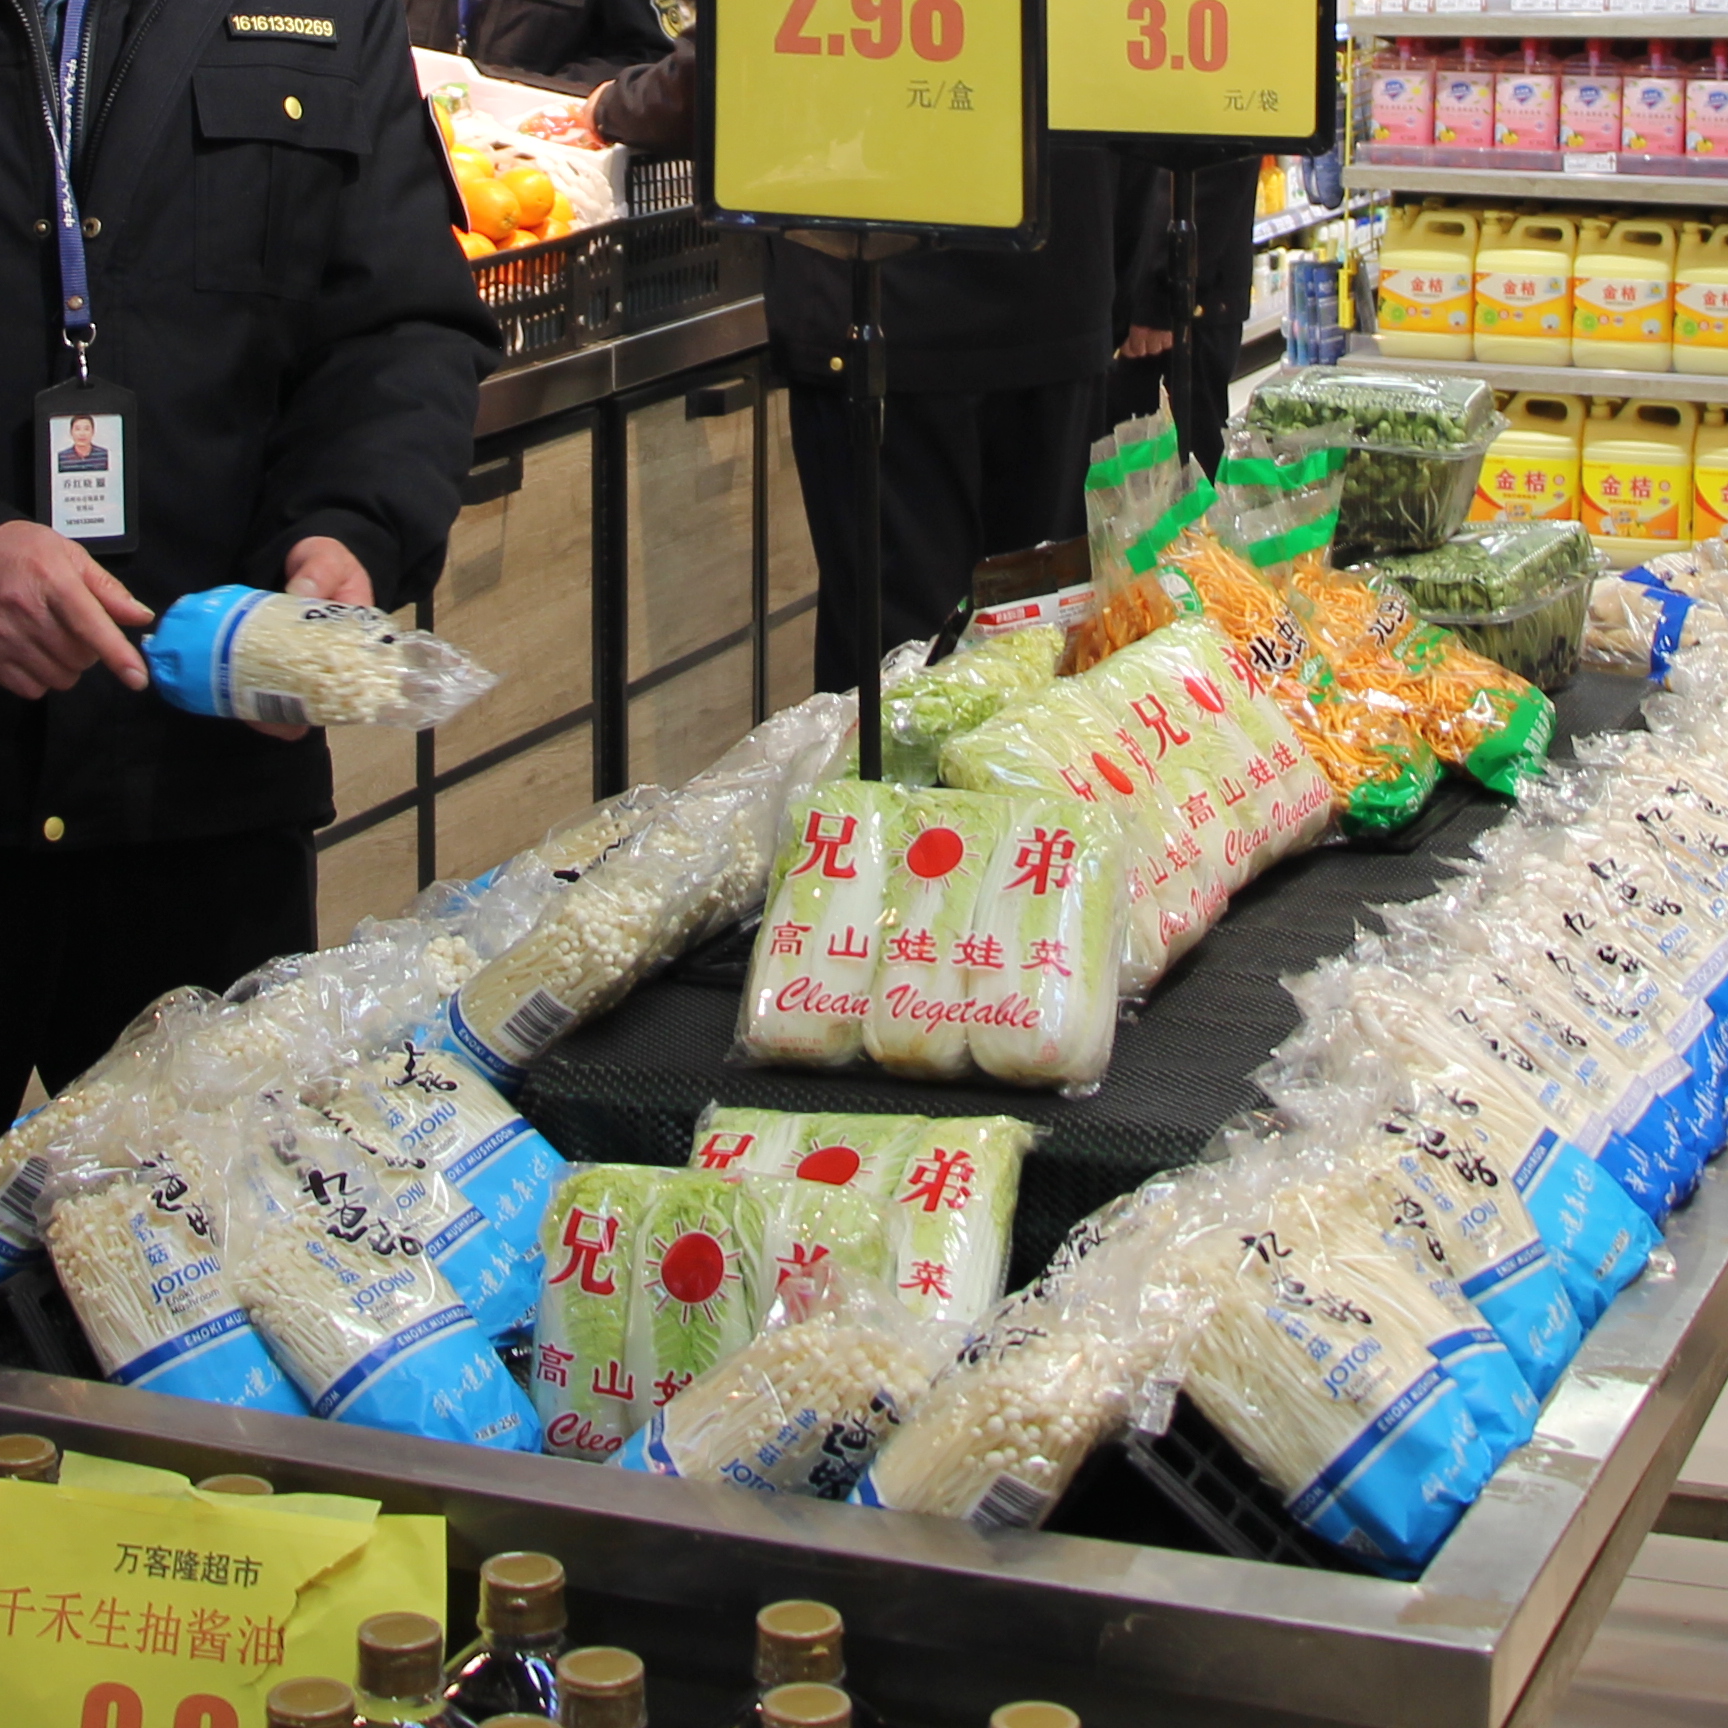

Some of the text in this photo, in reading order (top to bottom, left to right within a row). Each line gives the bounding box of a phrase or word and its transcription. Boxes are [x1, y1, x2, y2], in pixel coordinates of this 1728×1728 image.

[232, 14, 334, 38] 16161330269
[905, 79, 975, 112] 元/盒
[1222, 89, 1280, 112] 元/袋
[1410, 275, 1444, 296] 金桔
[1502, 279, 1536, 297] 金桔
[1603, 284, 1637, 303] 金桔
[1494, 468, 1547, 494] 金桔
[1600, 474, 1653, 499] 金桔
[1130, 693, 1192, 762] 兄
[1224, 775, 1331, 867] Clean Vegetable
[788, 809, 1077, 896] 兄 弟
[769, 920, 1073, 978] 高山娃娃菜
[774, 975, 1042, 1035] Clean Vegetable
[900, 1146, 975, 1213] 弟
[548, 1206, 618, 1296] 兄
[151, 1253, 222, 1305] JOTOKU
[350, 1267, 417, 1313] JOTOKU
[898, 1259, 954, 1301] 菜
[183, 1317, 224, 1348] ENOKI
[395, 1319, 428, 1348] ENOKI
[1323, 1335, 1384, 1398] JOTOKU
[1376, 1397, 1411, 1433] ENOKI
[113, 1542, 264, 1590] 万客隆超市
